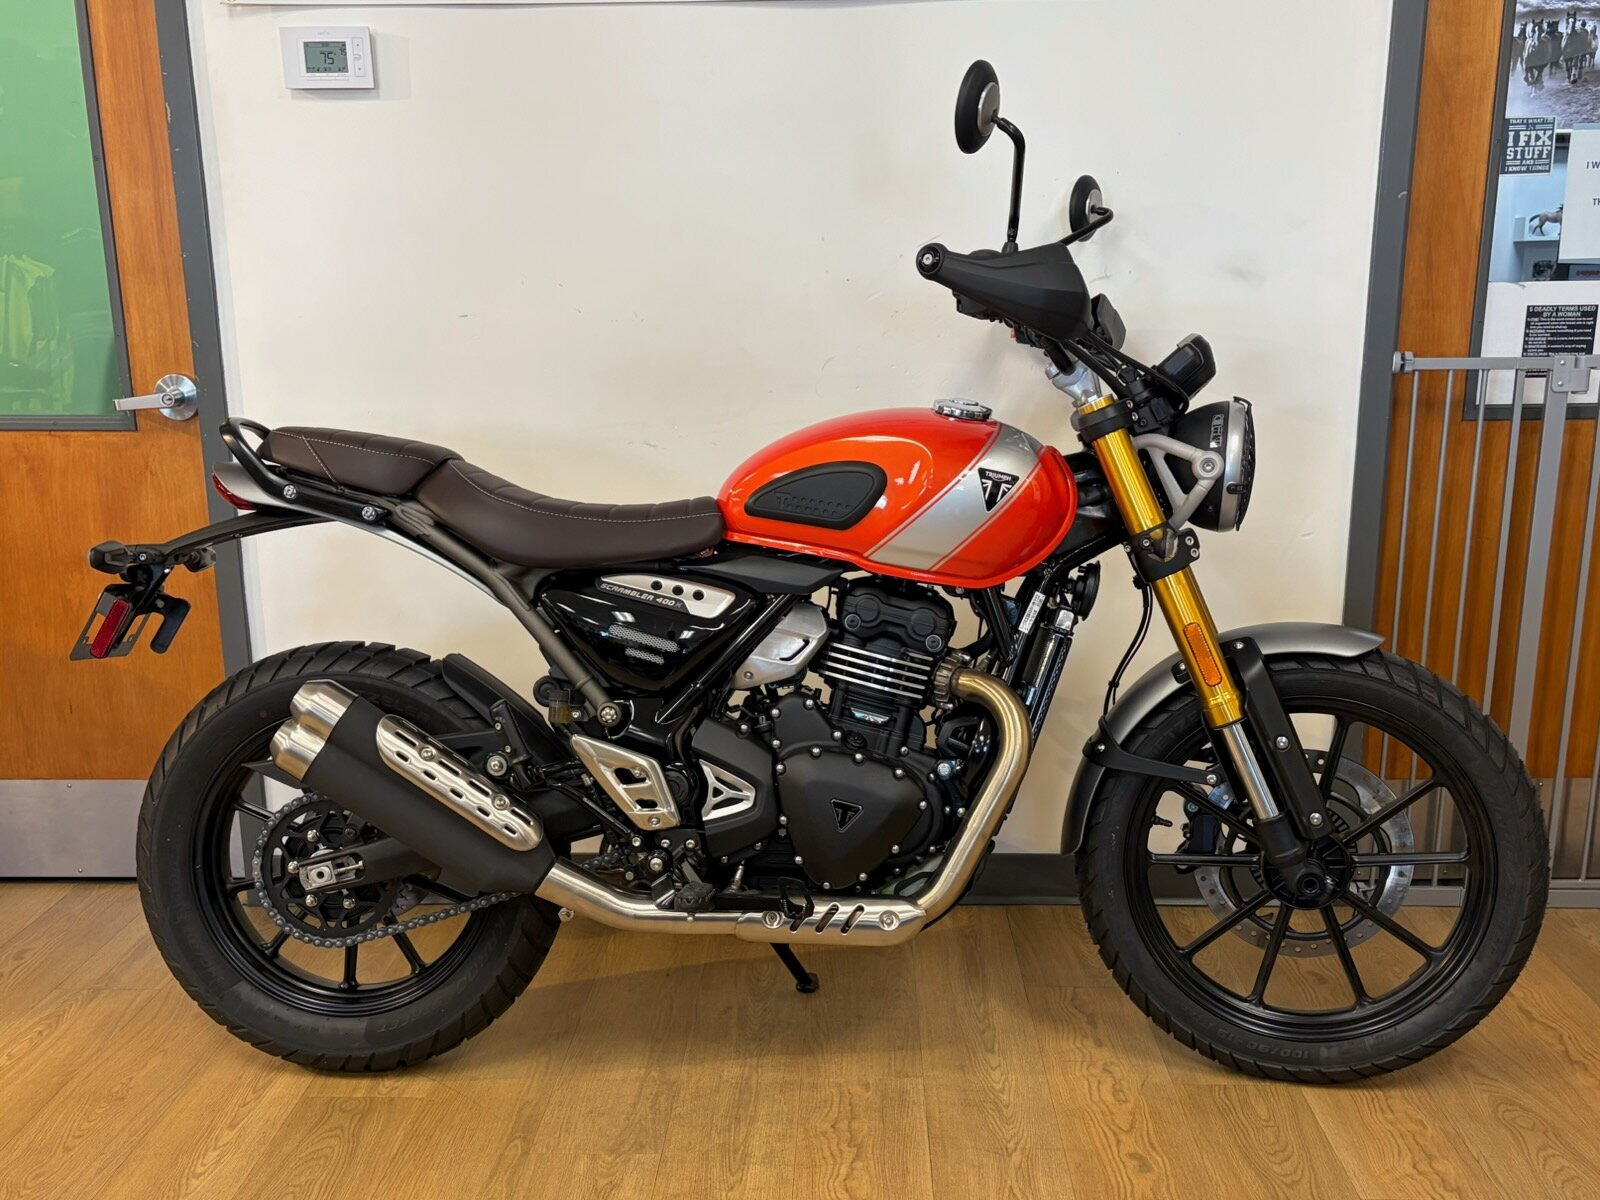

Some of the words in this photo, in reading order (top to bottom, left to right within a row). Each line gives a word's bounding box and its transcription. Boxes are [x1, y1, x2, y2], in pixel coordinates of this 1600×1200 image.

[1508, 131, 1515, 146] I
[1519, 130, 1552, 146] FIX
[1506, 146, 1551, 160] STUFF
[985, 471, 1012, 481] TRIUMPH
[600, 583, 655, 601] SCRAMBLER
